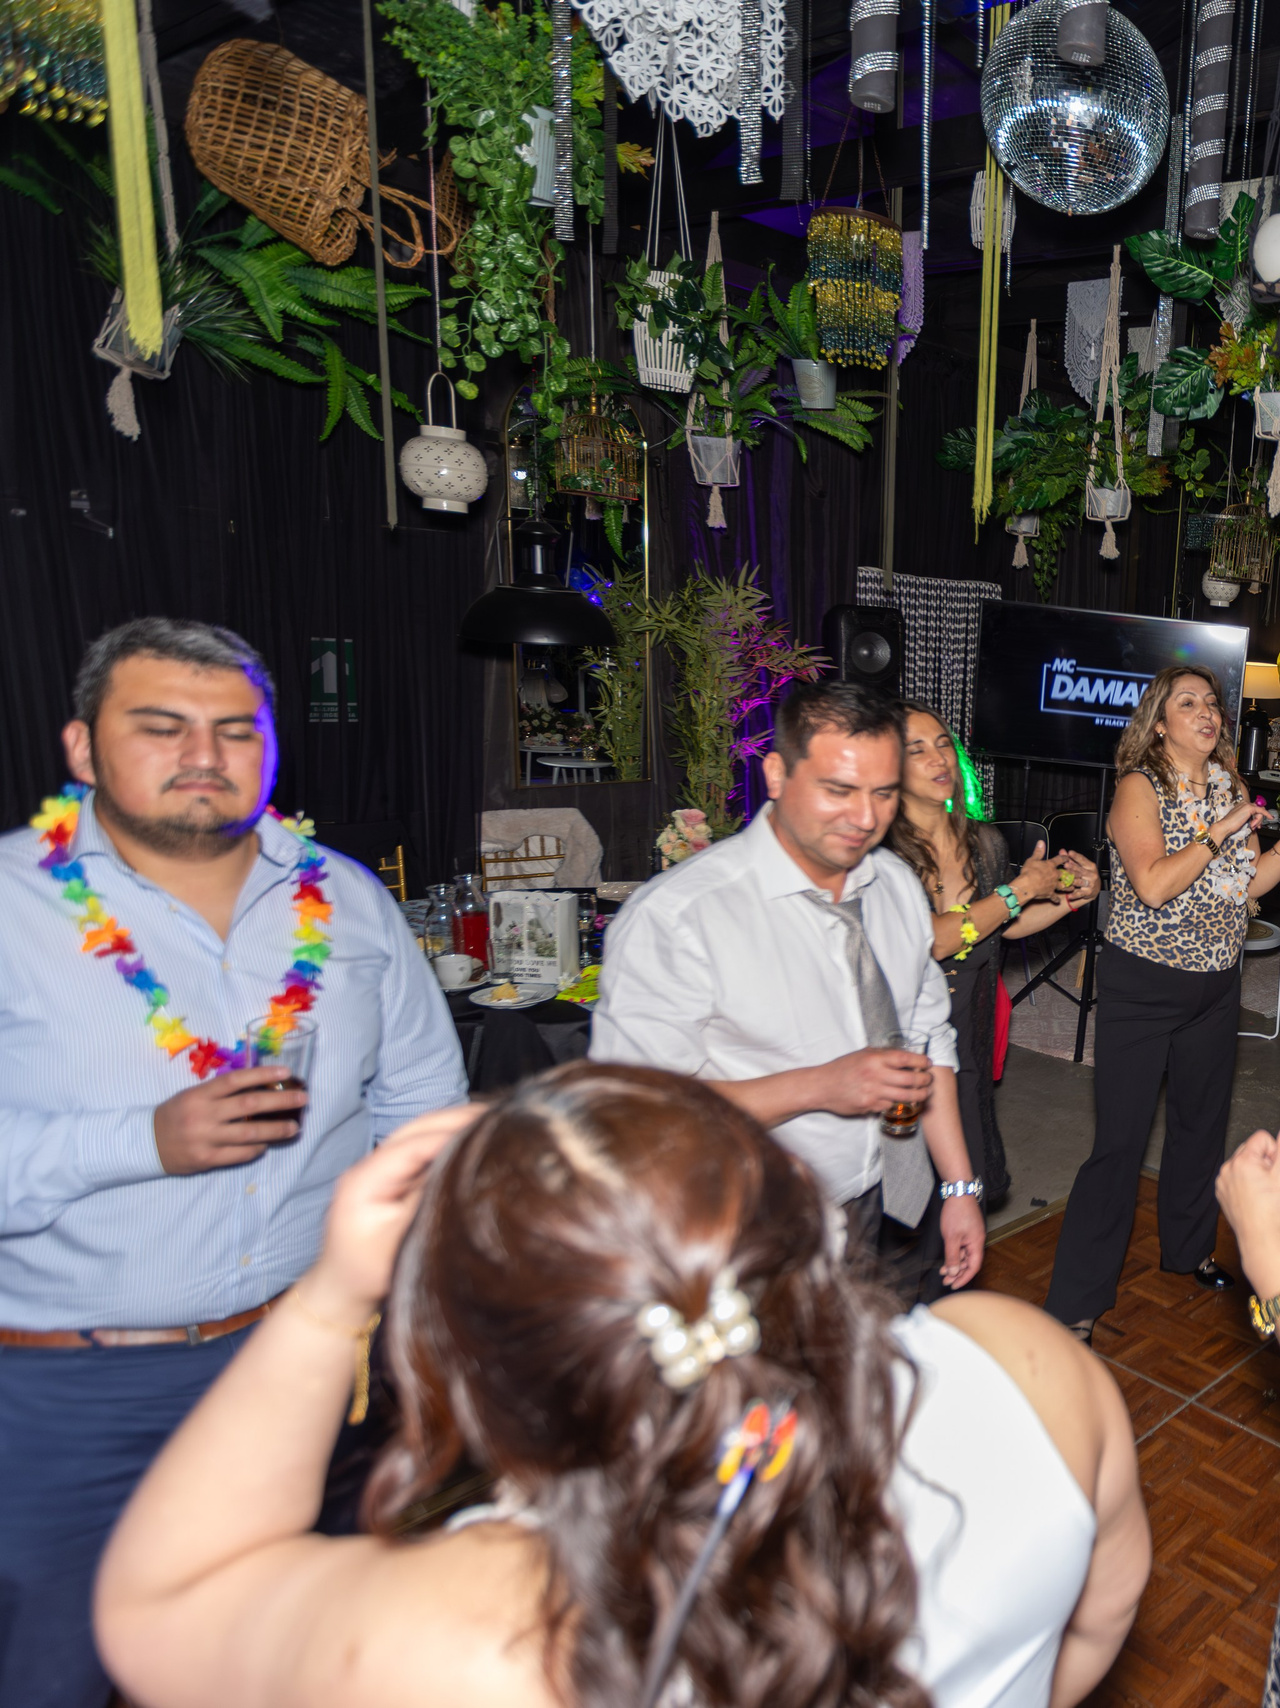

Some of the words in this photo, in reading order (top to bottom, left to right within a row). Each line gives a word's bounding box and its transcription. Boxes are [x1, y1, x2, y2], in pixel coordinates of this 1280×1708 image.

[1052, 657, 1077, 674] MC
[1095, 717, 1104, 725] BY
[1105, 718, 1124, 727] BLACK
